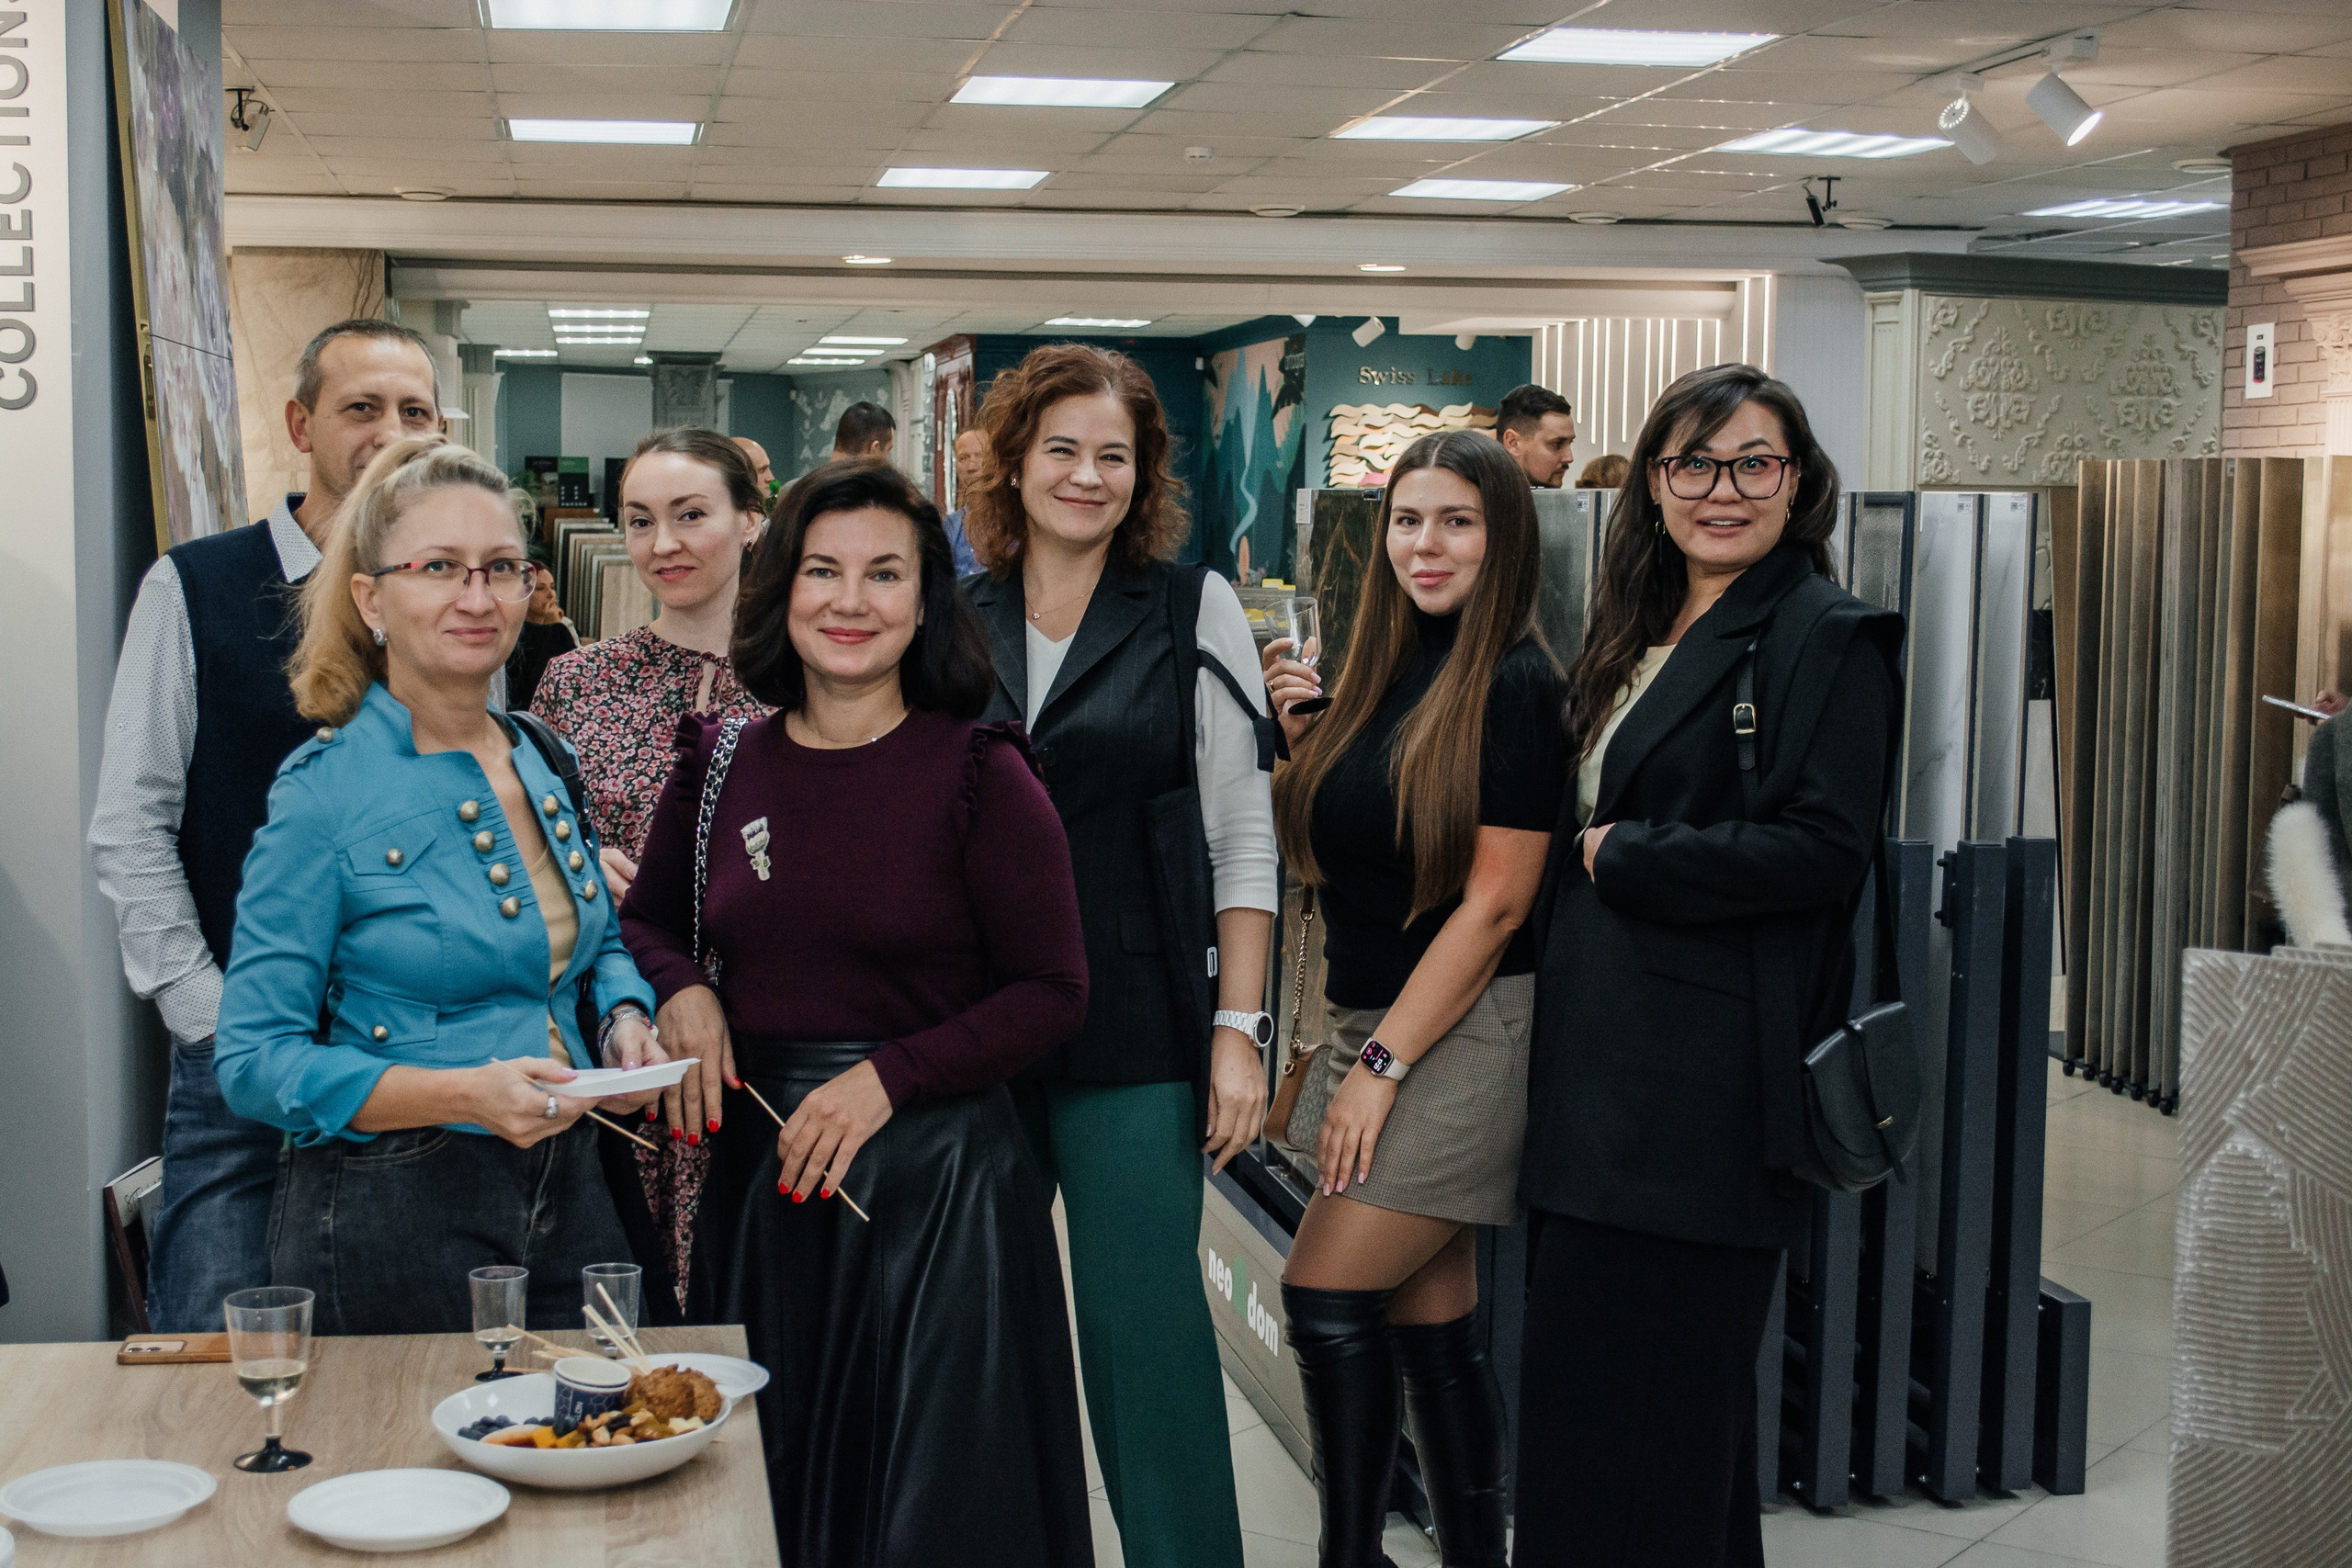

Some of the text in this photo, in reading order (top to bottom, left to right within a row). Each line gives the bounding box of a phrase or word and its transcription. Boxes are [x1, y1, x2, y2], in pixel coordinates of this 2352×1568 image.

[0, 0, 39, 411] COLLECTION
[1358, 366, 1475, 386] Swiss Lake
[1208, 1247, 1279, 1358] neo dom
